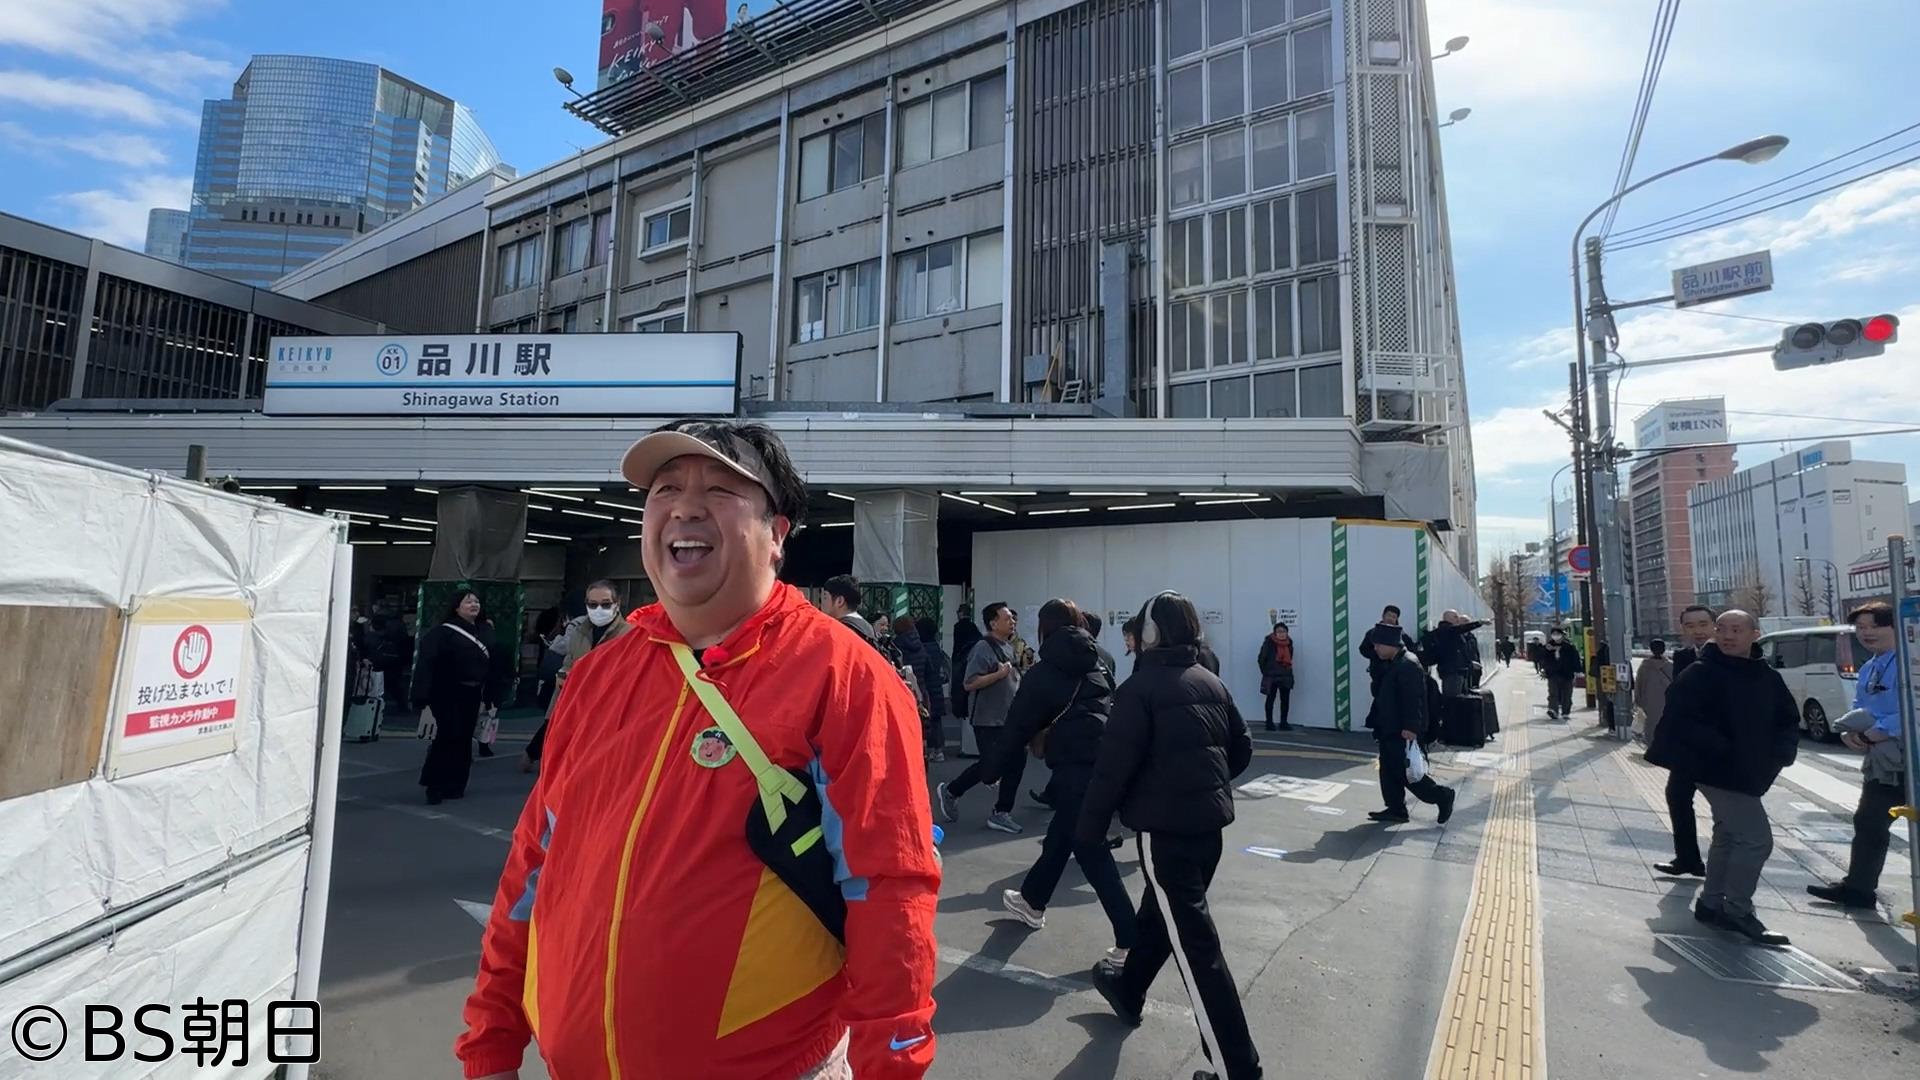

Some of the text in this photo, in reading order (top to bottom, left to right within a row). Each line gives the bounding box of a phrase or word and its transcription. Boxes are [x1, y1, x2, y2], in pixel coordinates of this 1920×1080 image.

[1682, 261, 1763, 290] 品川駅前
[1684, 281, 1739, 297] Shinagawa
[278, 346, 332, 361] KEIKYU
[417, 343, 551, 376] 品川駅
[382, 355, 400, 370] 01
[403, 391, 560, 409] Shinagawa Station
[1668, 419, 1723, 431] 東横INN
[149, 708, 218, 729] 監視カメラ作動中
